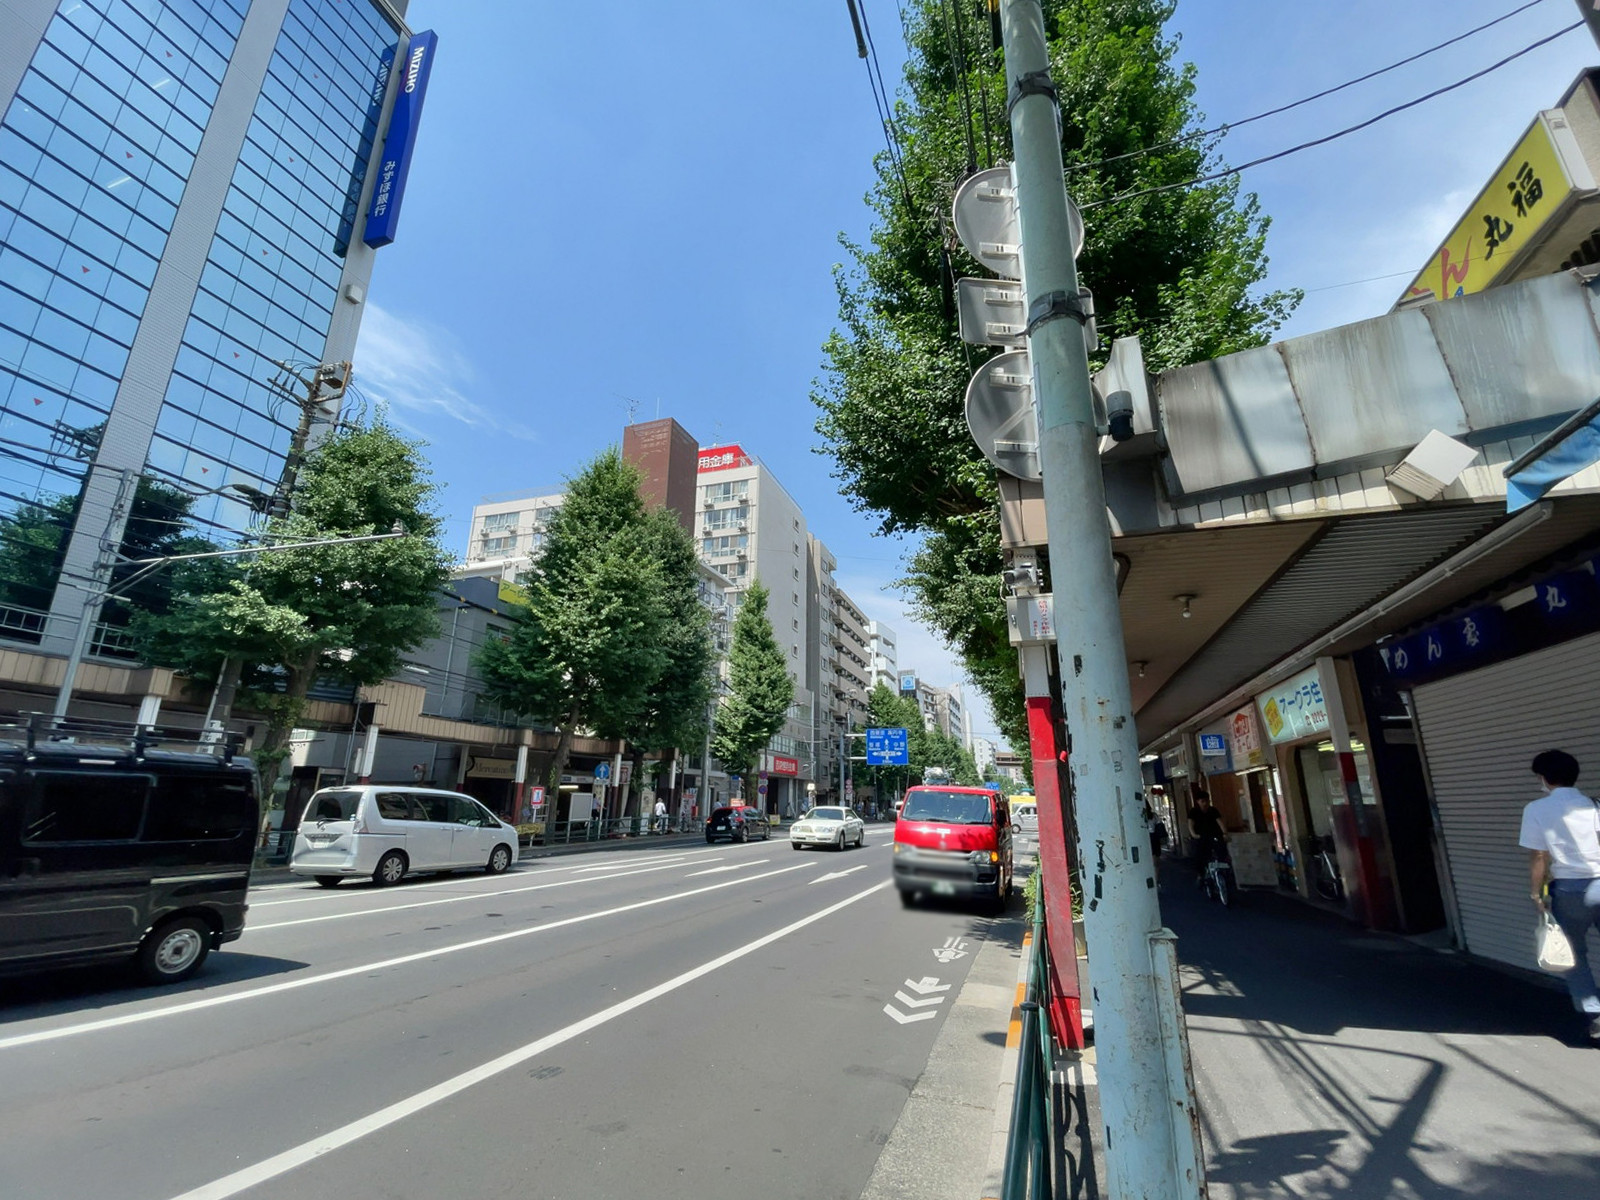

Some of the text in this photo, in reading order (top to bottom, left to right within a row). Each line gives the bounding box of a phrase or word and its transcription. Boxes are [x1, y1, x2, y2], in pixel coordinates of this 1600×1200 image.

[404, 46, 425, 93] MIZUHO
[374, 161, 396, 217] みずほ銀行
